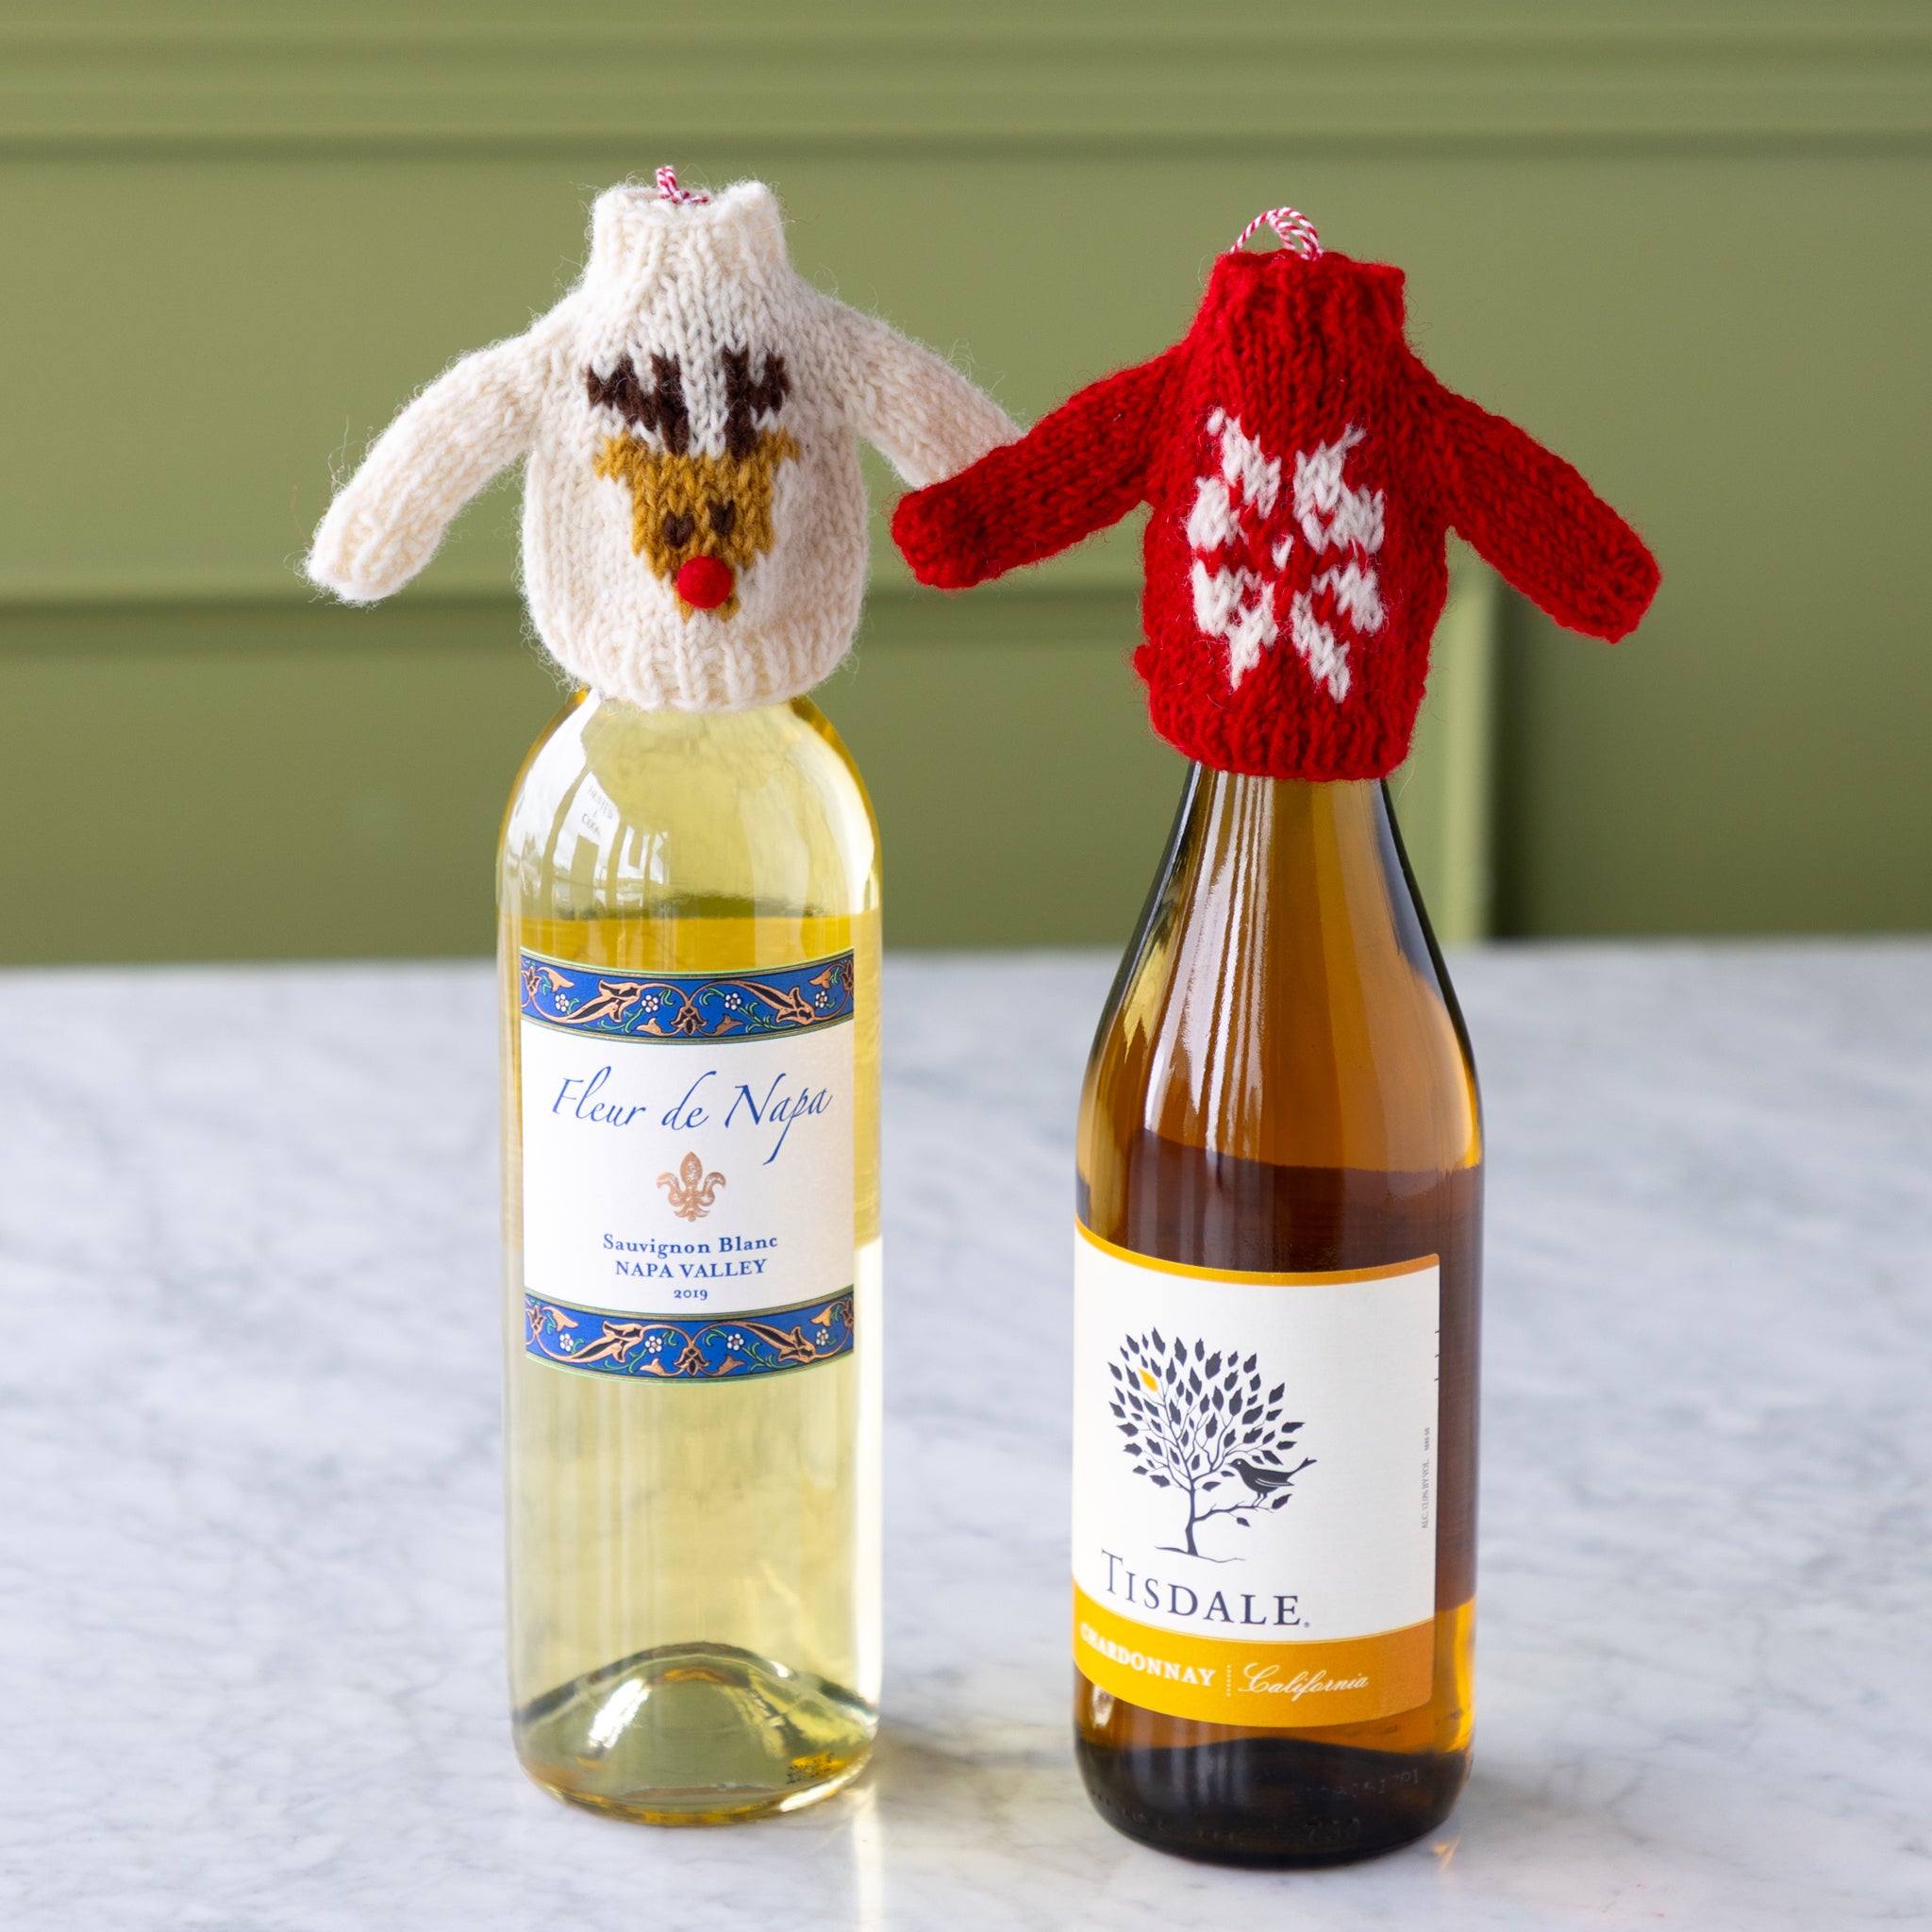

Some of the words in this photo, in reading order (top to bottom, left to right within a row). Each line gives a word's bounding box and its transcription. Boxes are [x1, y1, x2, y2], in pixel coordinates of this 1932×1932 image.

[552, 1066, 646, 1127] Fleur
[661, 1071, 717, 1130] de
[724, 1073, 833, 1166] Napa
[603, 1233, 711, 1258] Sauvignon
[719, 1235, 778, 1254] Blanc
[615, 1260, 674, 1278] NAPA
[680, 1258, 767, 1278] VALLEY
[674, 1289, 708, 1300] 2019
[1101, 1548, 1302, 1626] TISDALE
[1080, 1623, 1216, 1687] CHARDONNAY
[1238, 1662, 1369, 1702] California
